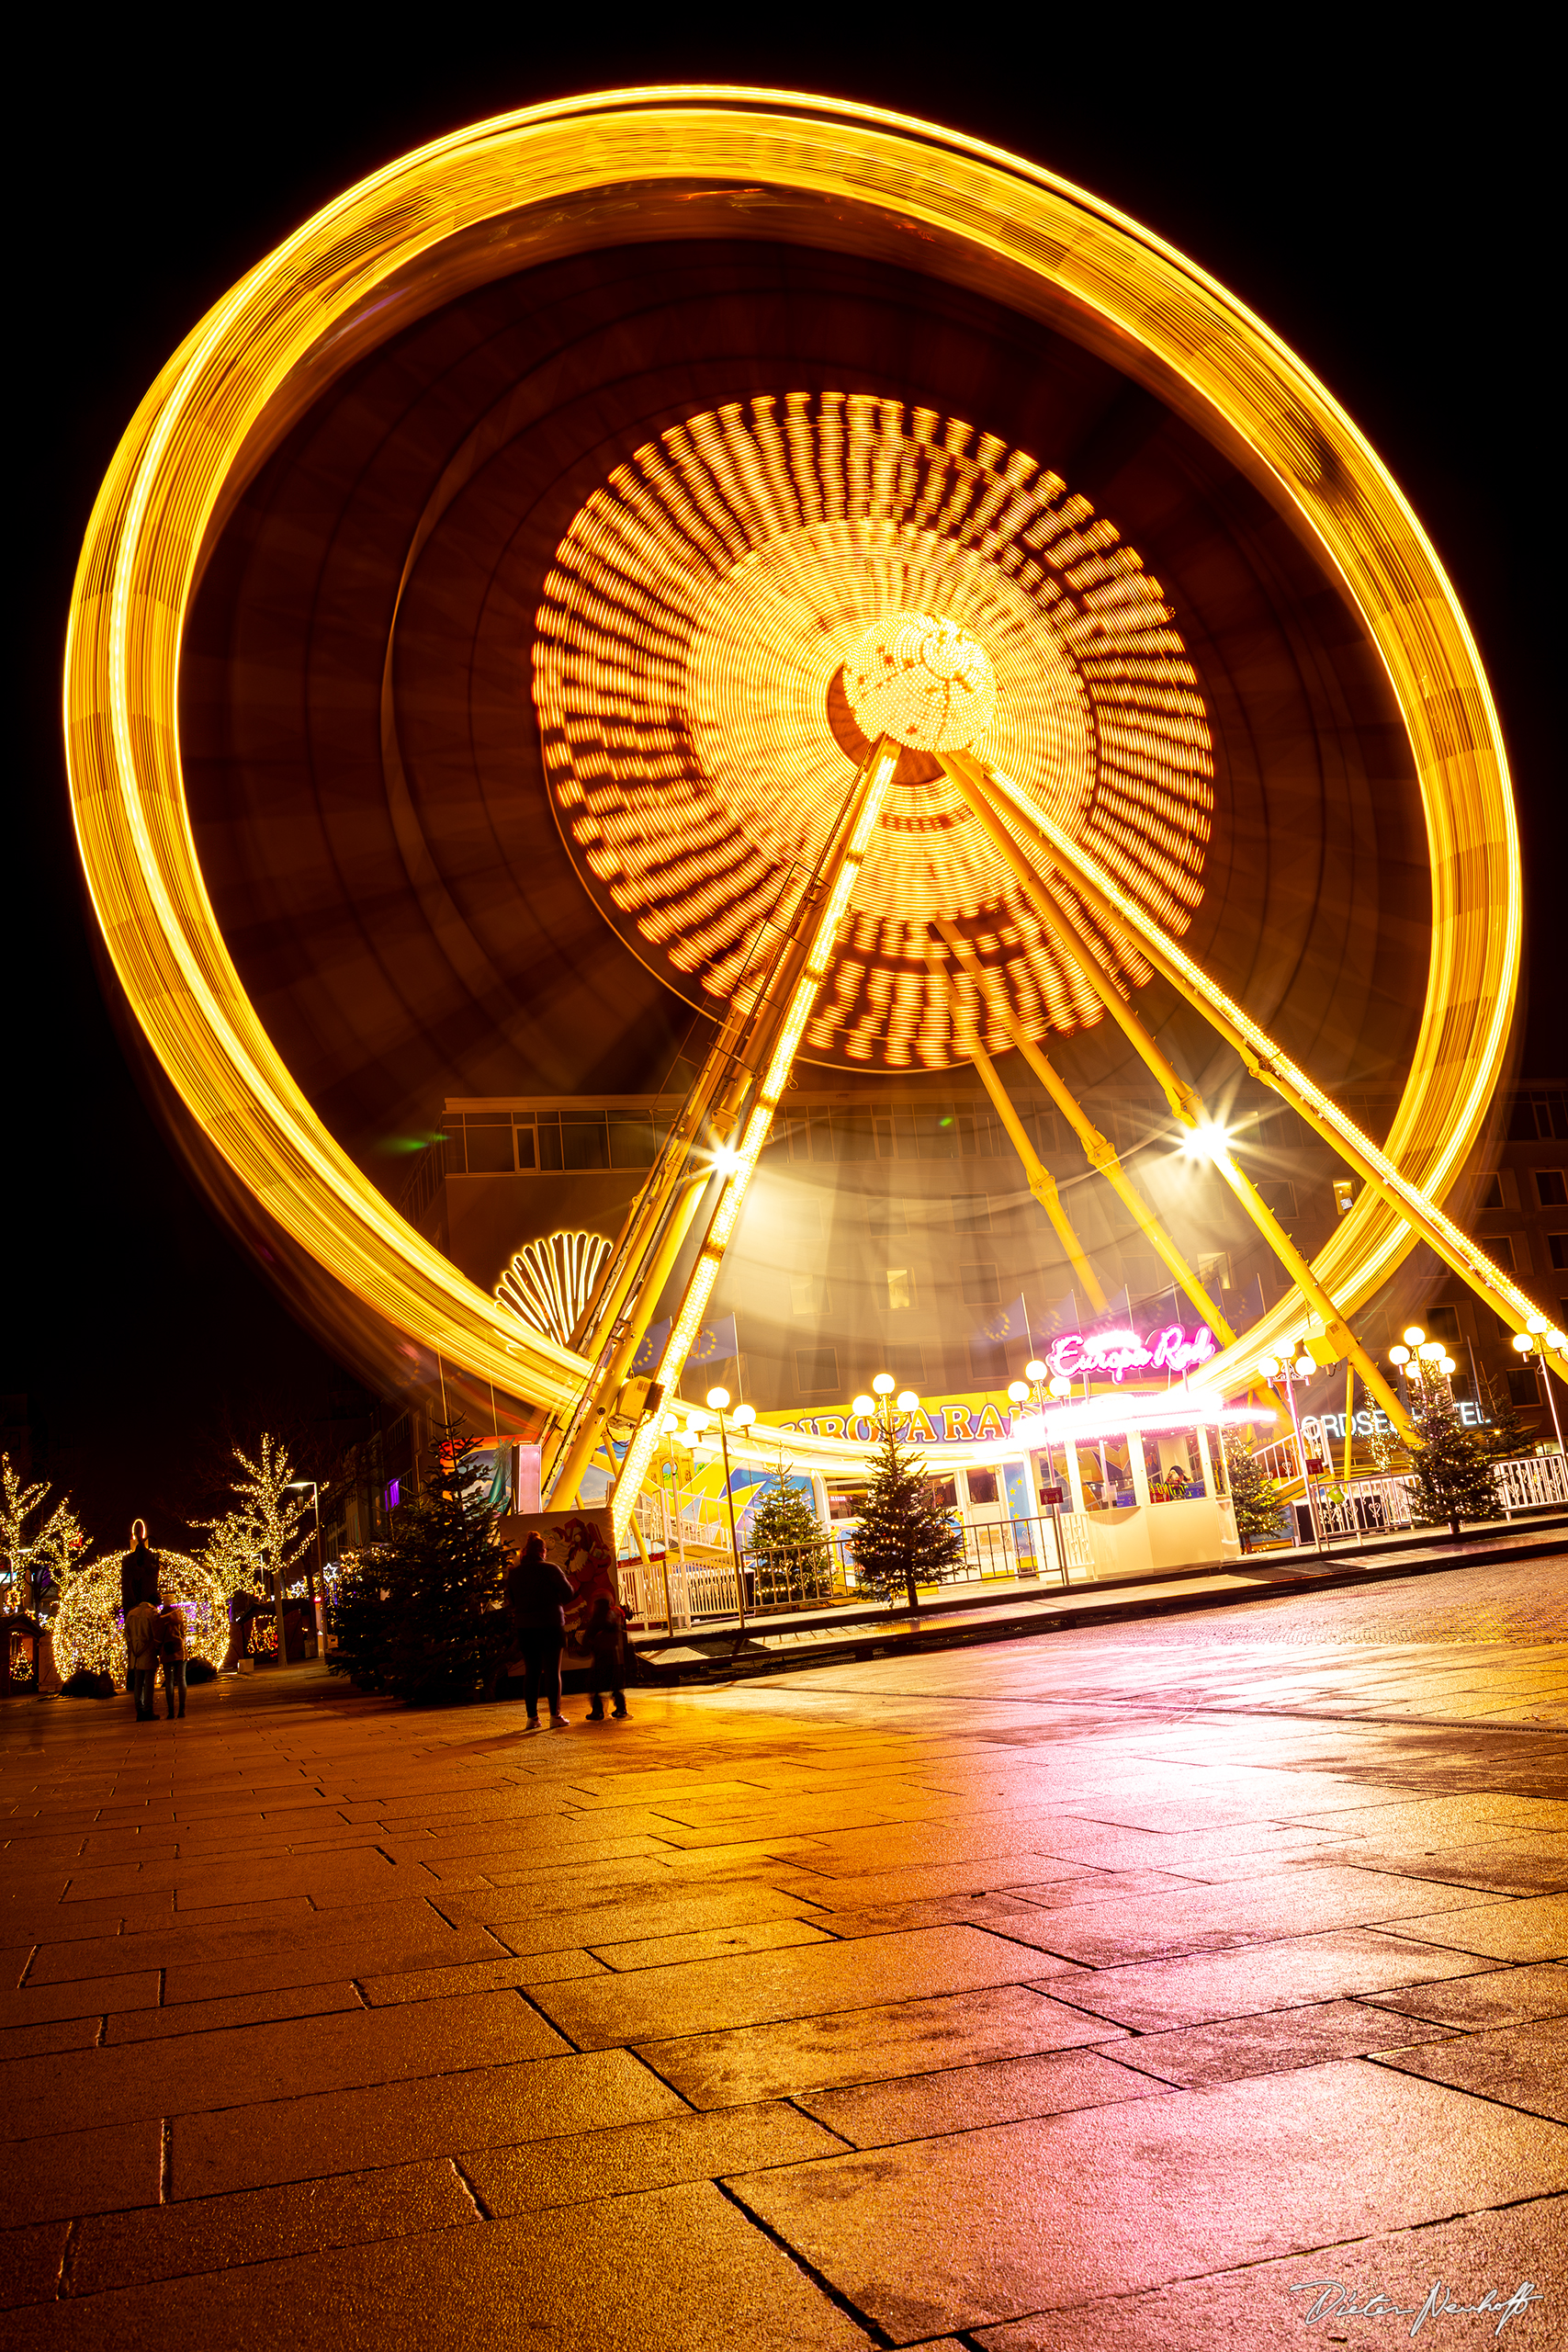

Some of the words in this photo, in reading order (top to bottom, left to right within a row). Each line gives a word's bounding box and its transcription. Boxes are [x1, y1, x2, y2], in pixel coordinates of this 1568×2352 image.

[1046, 1334, 1152, 1385] Europa
[1148, 1324, 1215, 1371] Rad
[1296, 1408, 1398, 1441] ORDSE
